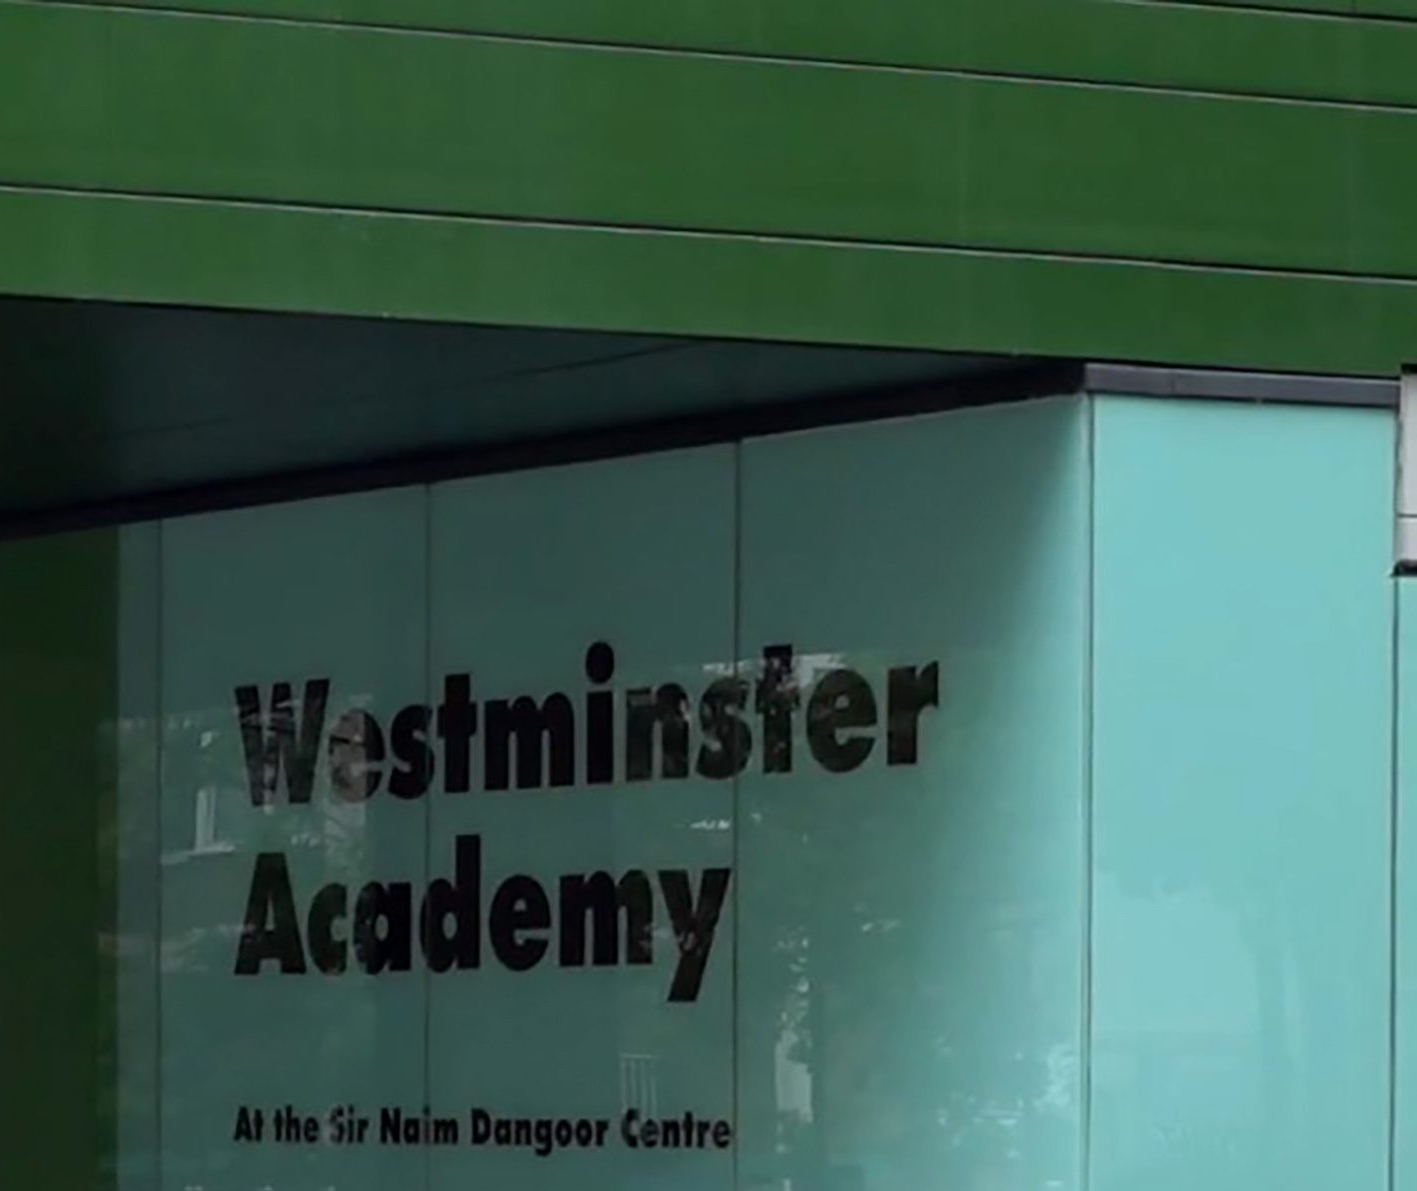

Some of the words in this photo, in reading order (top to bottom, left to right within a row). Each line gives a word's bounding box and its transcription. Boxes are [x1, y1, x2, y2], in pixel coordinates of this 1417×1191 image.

[234, 641, 940, 808] Westminster
[233, 834, 732, 1004] Academy
[234, 1106, 267, 1144] At
[273, 1106, 320, 1145] the
[328, 1107, 369, 1147] Sir
[379, 1107, 459, 1147] Naim
[470, 1108, 610, 1157] Dangoor
[620, 1109, 732, 1149] Centre
